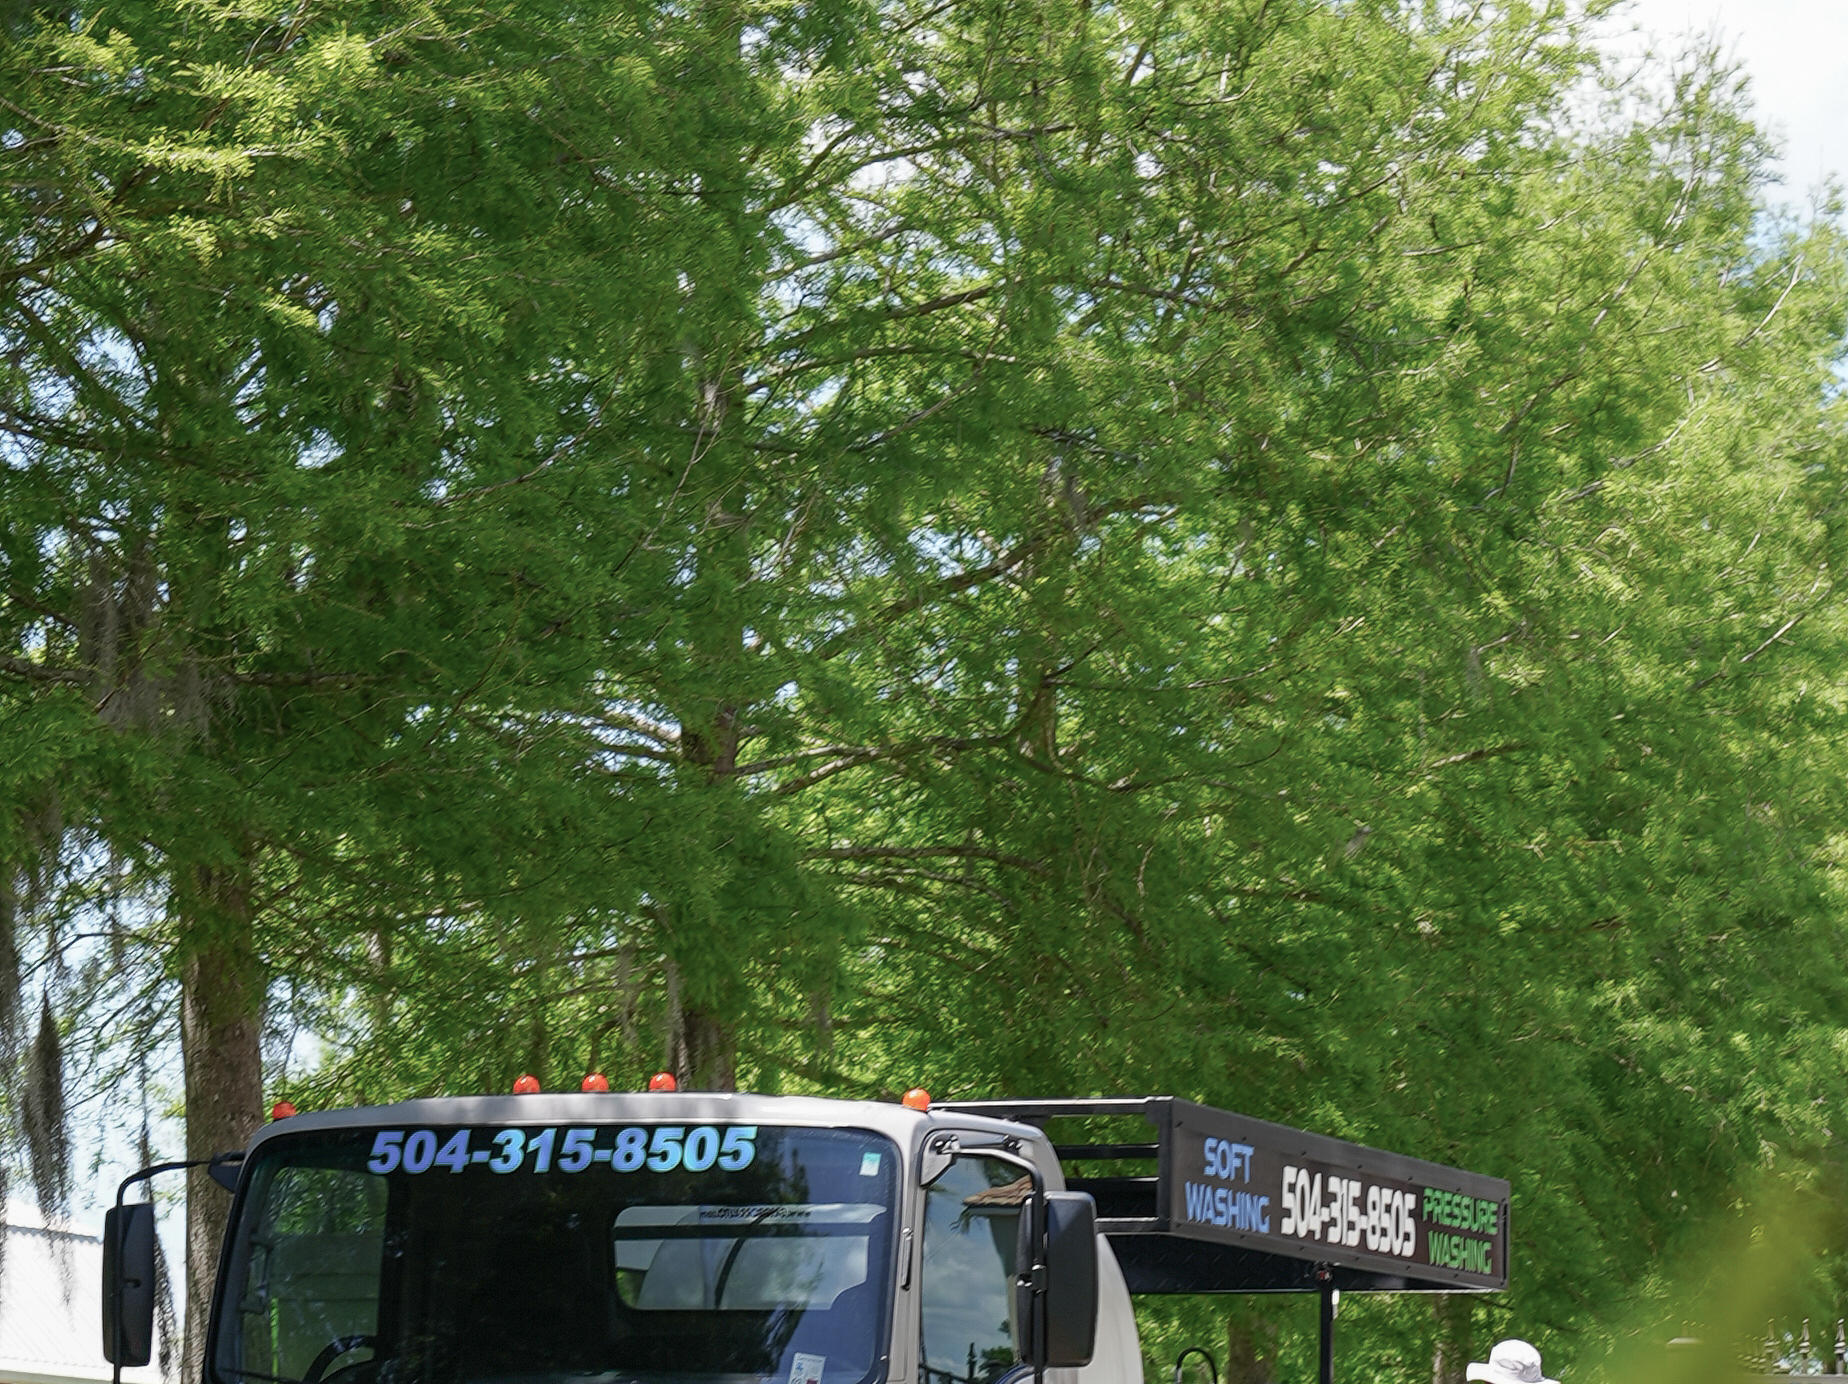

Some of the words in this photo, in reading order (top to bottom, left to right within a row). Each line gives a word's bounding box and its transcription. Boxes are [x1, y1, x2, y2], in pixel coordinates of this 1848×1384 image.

[367, 1125, 759, 1175] 504-315-8505
[1203, 1137, 1255, 1184] SOFT
[1185, 1181, 1271, 1234] WASHING
[1281, 1165, 1417, 1258] 504-315-8505
[1422, 1187, 1499, 1236] PRESSURE
[1427, 1230, 1493, 1275] WASHING
